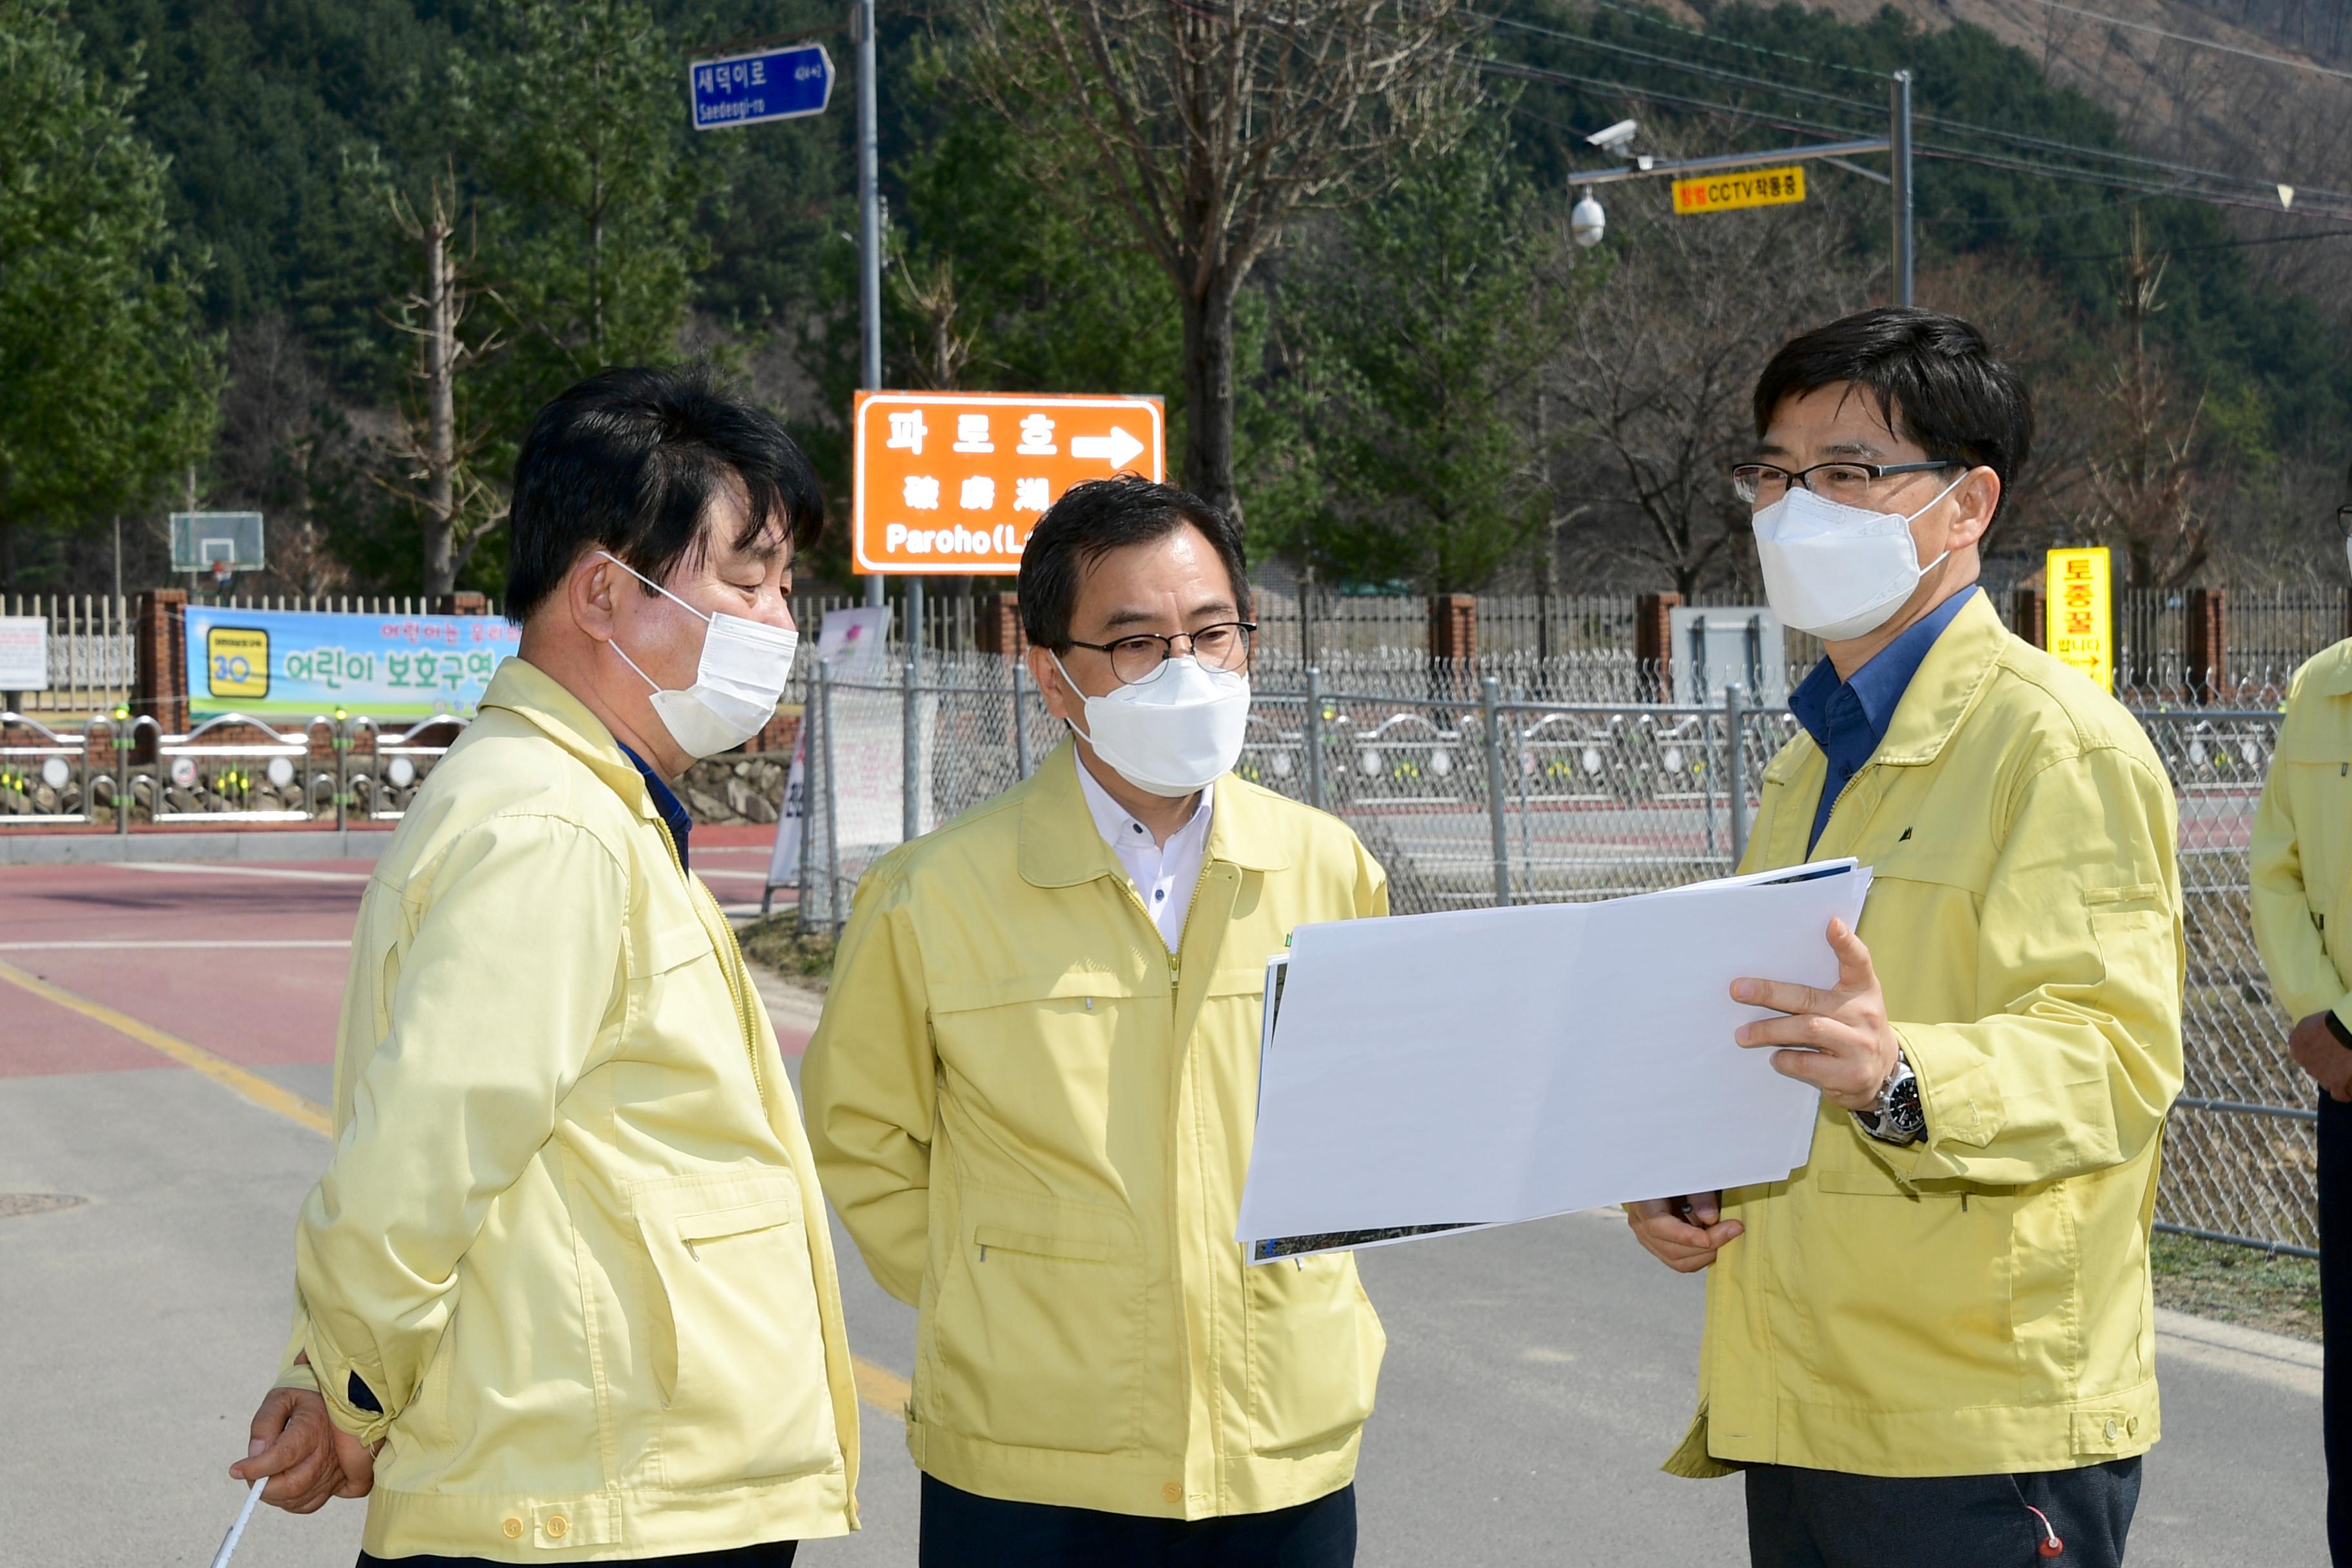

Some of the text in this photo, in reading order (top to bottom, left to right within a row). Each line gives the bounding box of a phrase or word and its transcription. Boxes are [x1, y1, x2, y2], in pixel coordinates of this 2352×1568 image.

[698, 62, 767, 94] 새덕이로
[2064, 560, 2093, 634] 토종꿀
[286, 650, 493, 689] 어린이 보호구역
